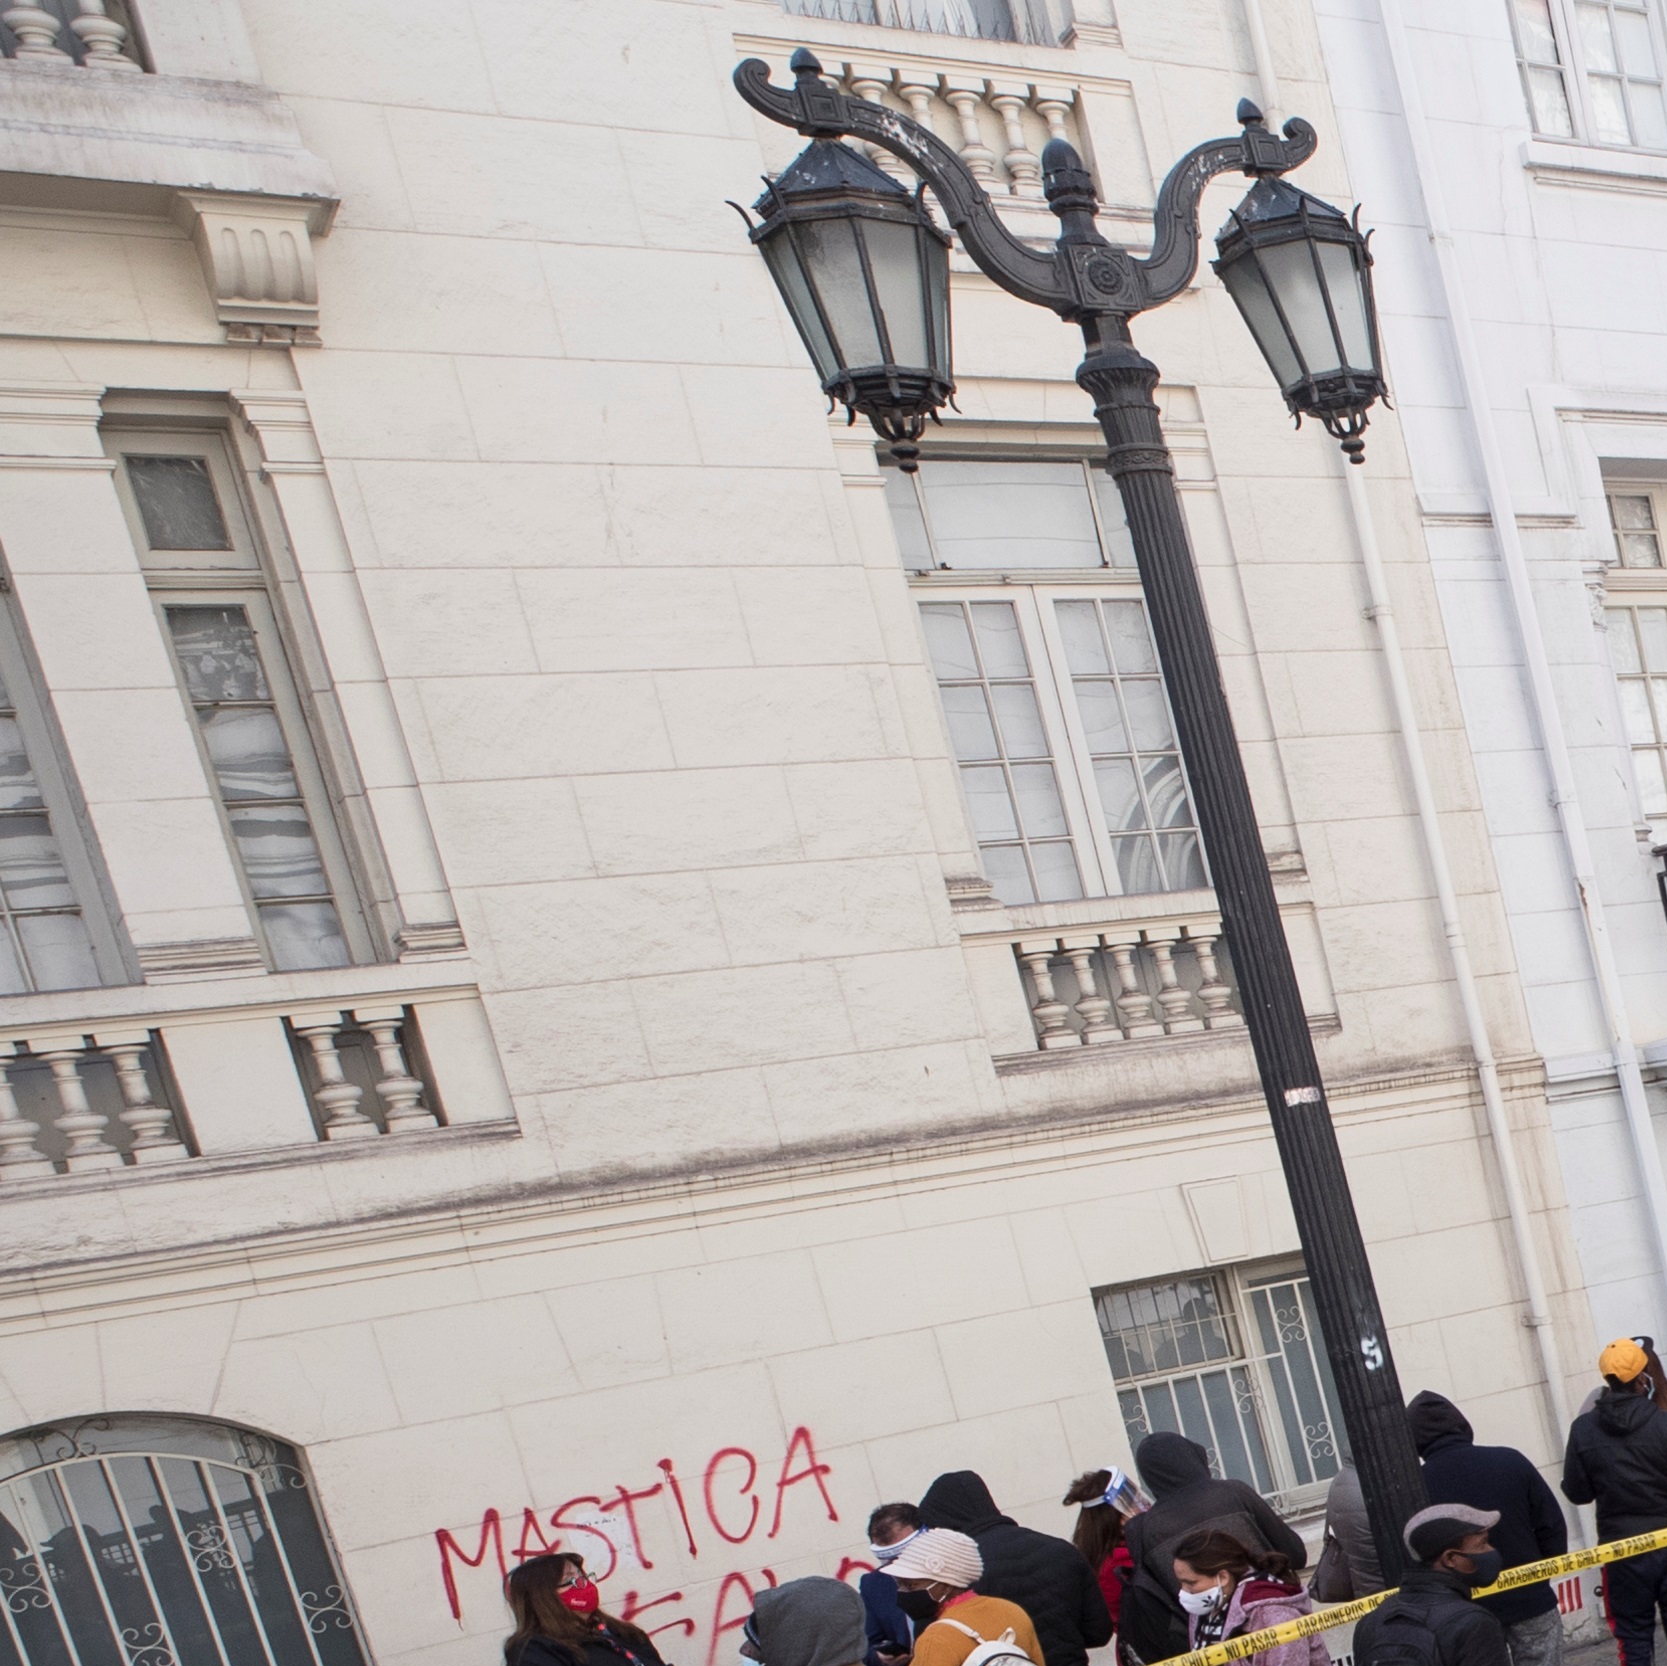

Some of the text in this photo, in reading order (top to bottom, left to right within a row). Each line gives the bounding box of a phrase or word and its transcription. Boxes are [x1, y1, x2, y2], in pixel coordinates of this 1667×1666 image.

[435, 1426, 839, 1630] MASTICA
[1224, 1639, 1241, 1661] NO
[1242, 1629, 1279, 1655] PASAR
[1295, 1601, 1366, 1637] CARABINEROS
